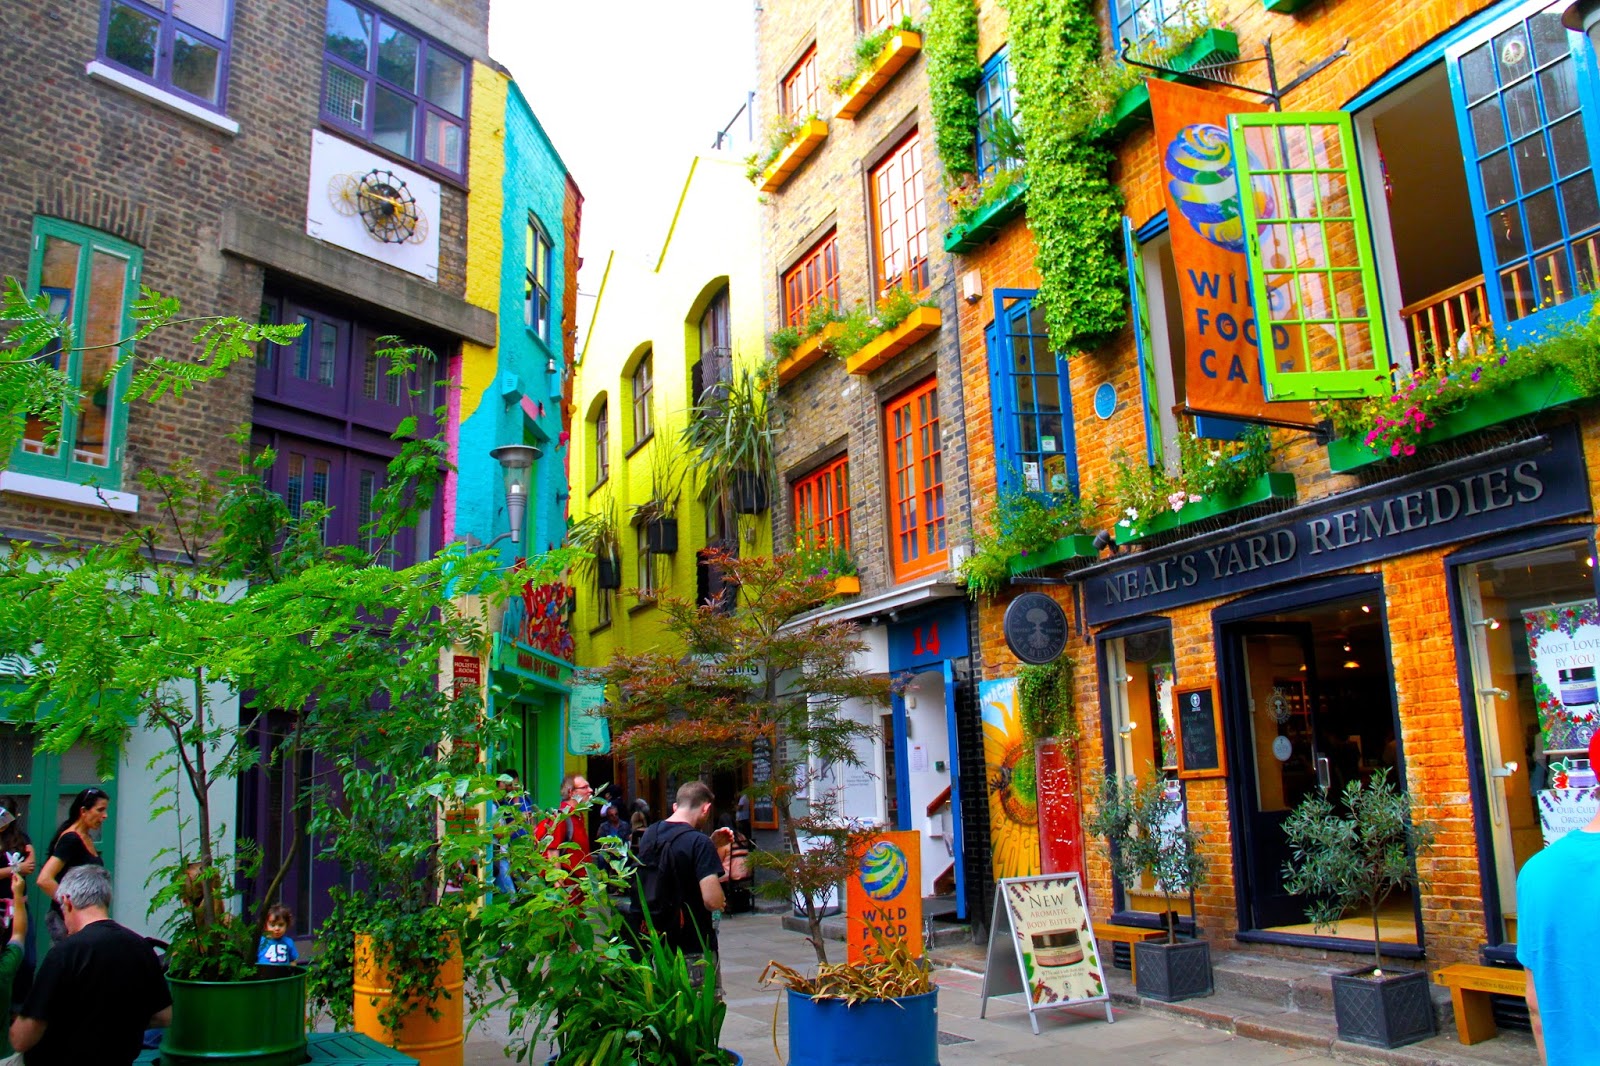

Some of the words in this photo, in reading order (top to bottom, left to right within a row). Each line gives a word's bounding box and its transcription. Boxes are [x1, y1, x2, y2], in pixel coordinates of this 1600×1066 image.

[1196, 307, 1290, 351] FOOD
[1104, 554, 1199, 606] NEAL'S
[1205, 529, 1297, 580] YARD
[1306, 460, 1544, 555] REMEDIES
[912, 621, 941, 656] 14
[1540, 642, 1569, 655] MOST
[1573, 638, 1600, 651] LOVE
[454, 661, 478, 669] HOLISTIC
[1555, 657, 1568, 668] BY
[1569, 654, 1596, 666] YOU
[980, 682, 1017, 711] IMAGIN
[1556, 806, 1574, 814] OUR
[1576, 806, 1596, 814] CULT
[1560, 815, 1592, 824] ORGANI
[1029, 893, 1064, 909] NEW
[862, 907, 907, 922] WILD
[1030, 907, 1068, 918] AROMATIC
[1026, 921, 1047, 930] BODY
[1050, 917, 1077, 927] BUTTER
[862, 925, 907, 940] FOOD
[264, 944, 288, 963] 45
